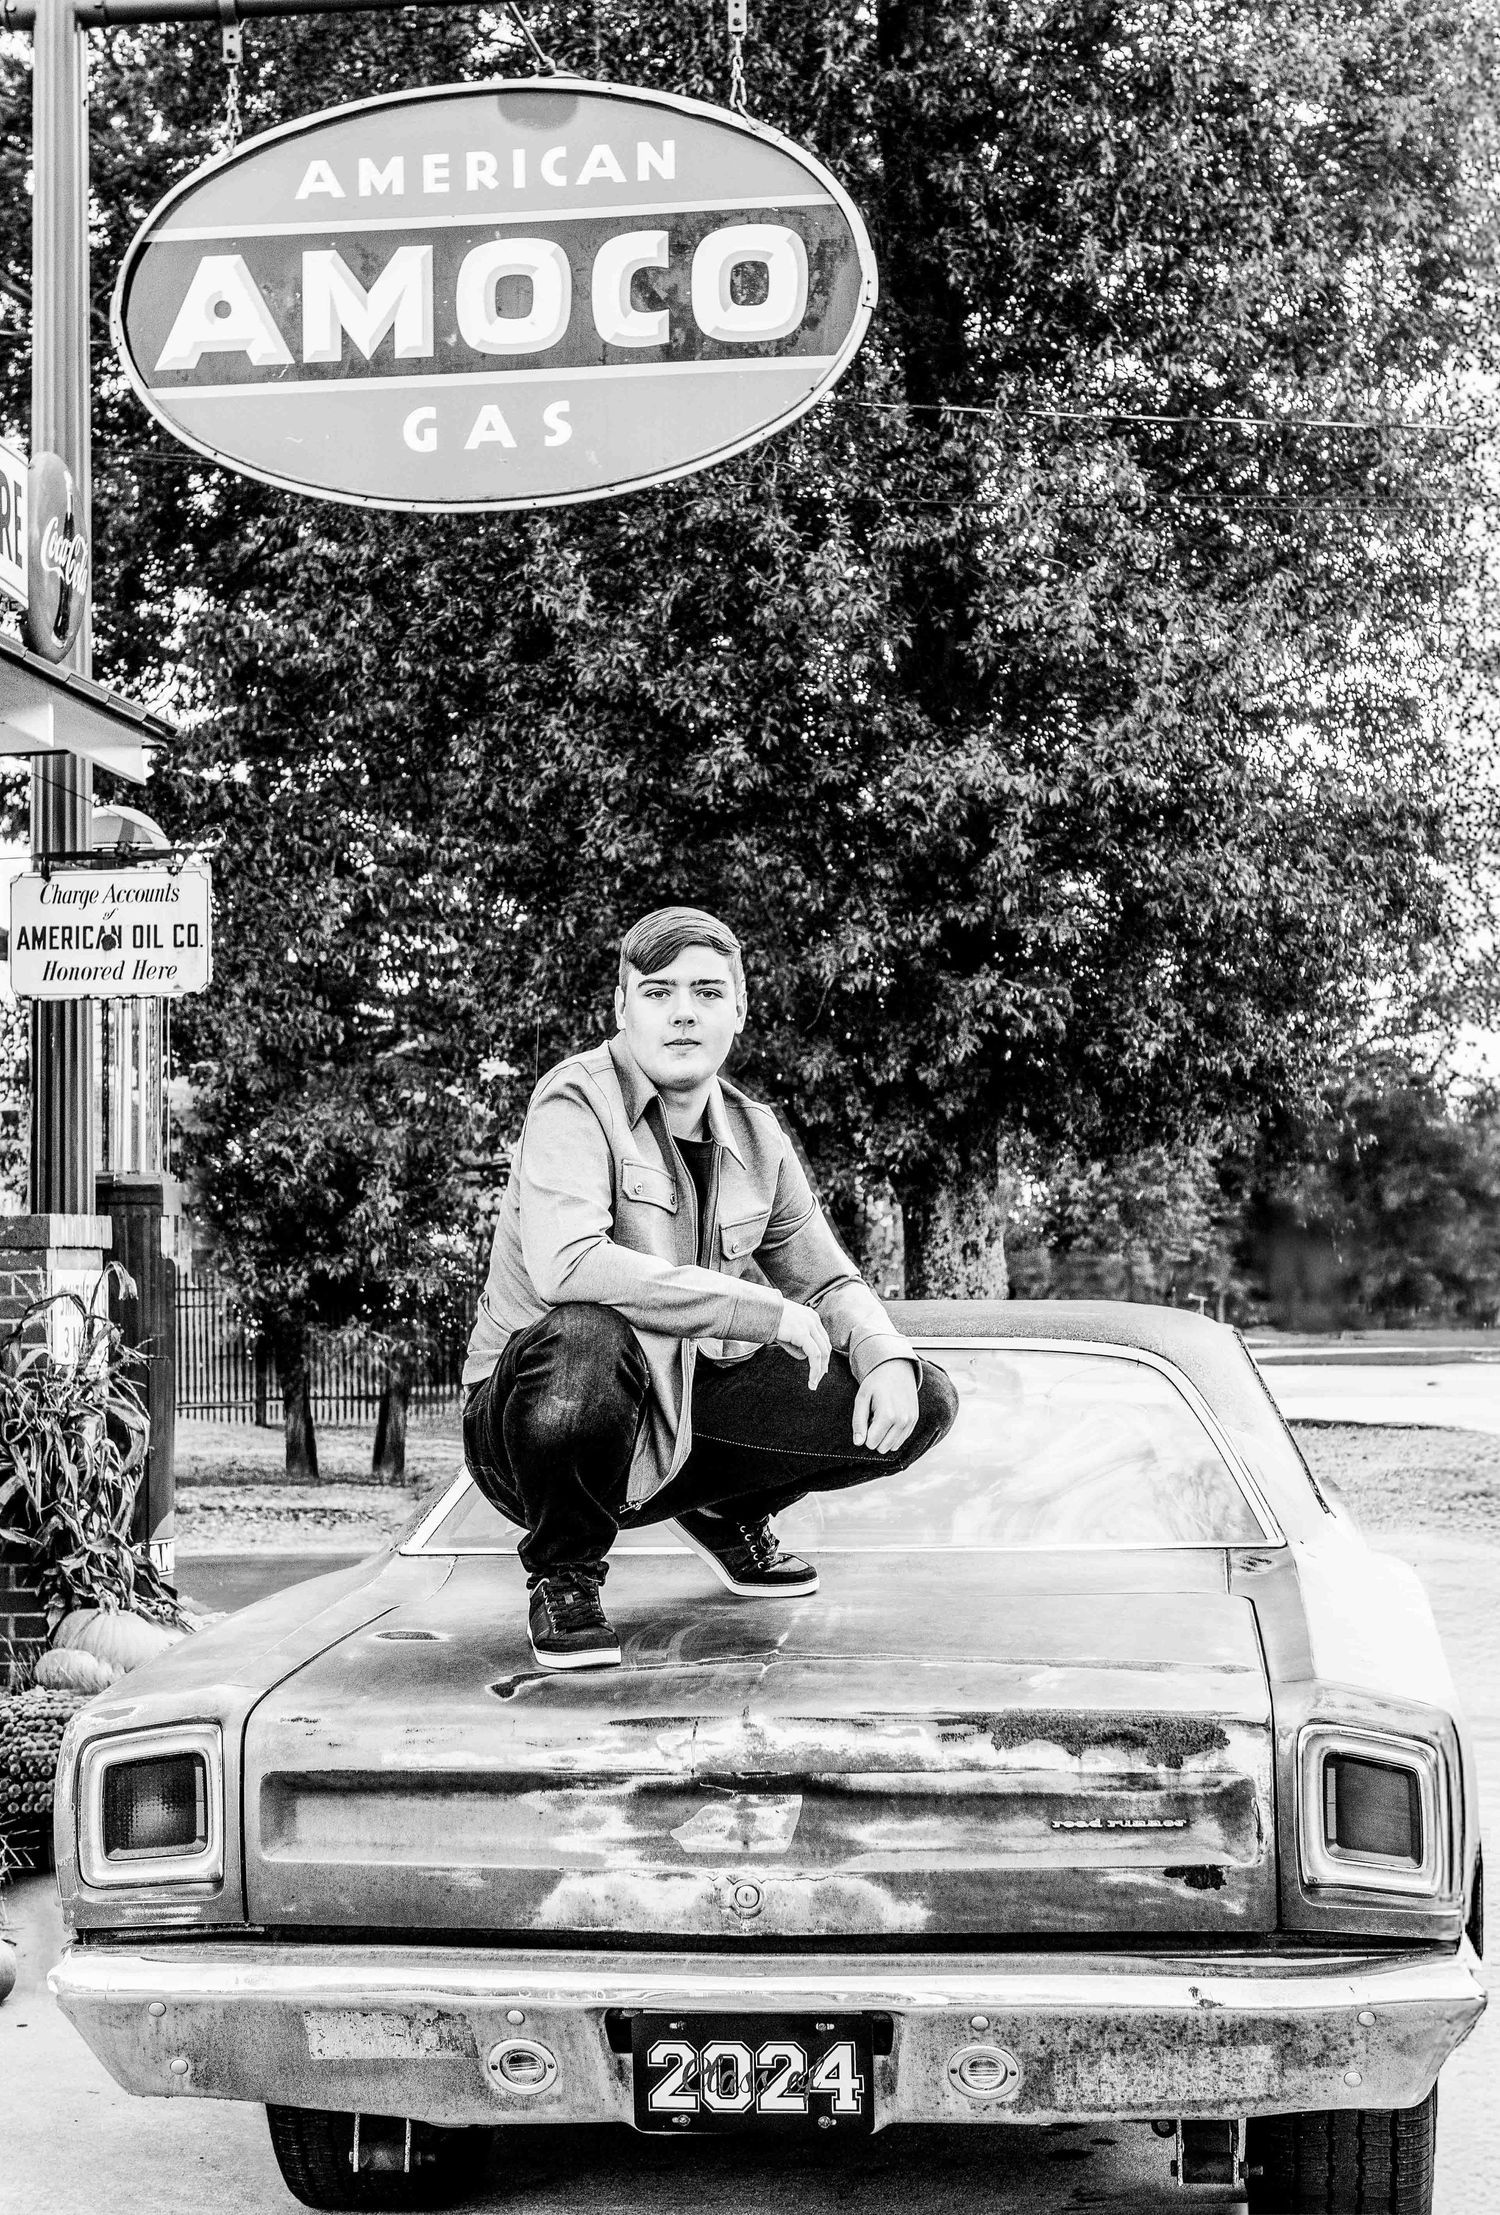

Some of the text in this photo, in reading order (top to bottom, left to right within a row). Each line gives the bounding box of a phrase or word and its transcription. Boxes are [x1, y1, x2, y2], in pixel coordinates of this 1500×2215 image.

[295, 139, 676, 200] AMERICAN
[153, 223, 809, 371] AMOCO
[403, 400, 573, 452] GAS
[39, 882, 181, 910] Charge Accounts
[102, 908, 119, 920] of
[133, 924, 164, 949] OIL
[173, 923, 204, 948] CO.
[42, 959, 178, 982] Honored Here
[1051, 1818, 1187, 1828] road runner
[647, 2040, 865, 2114] 2024
[682, 2053, 769, 2094] Class
